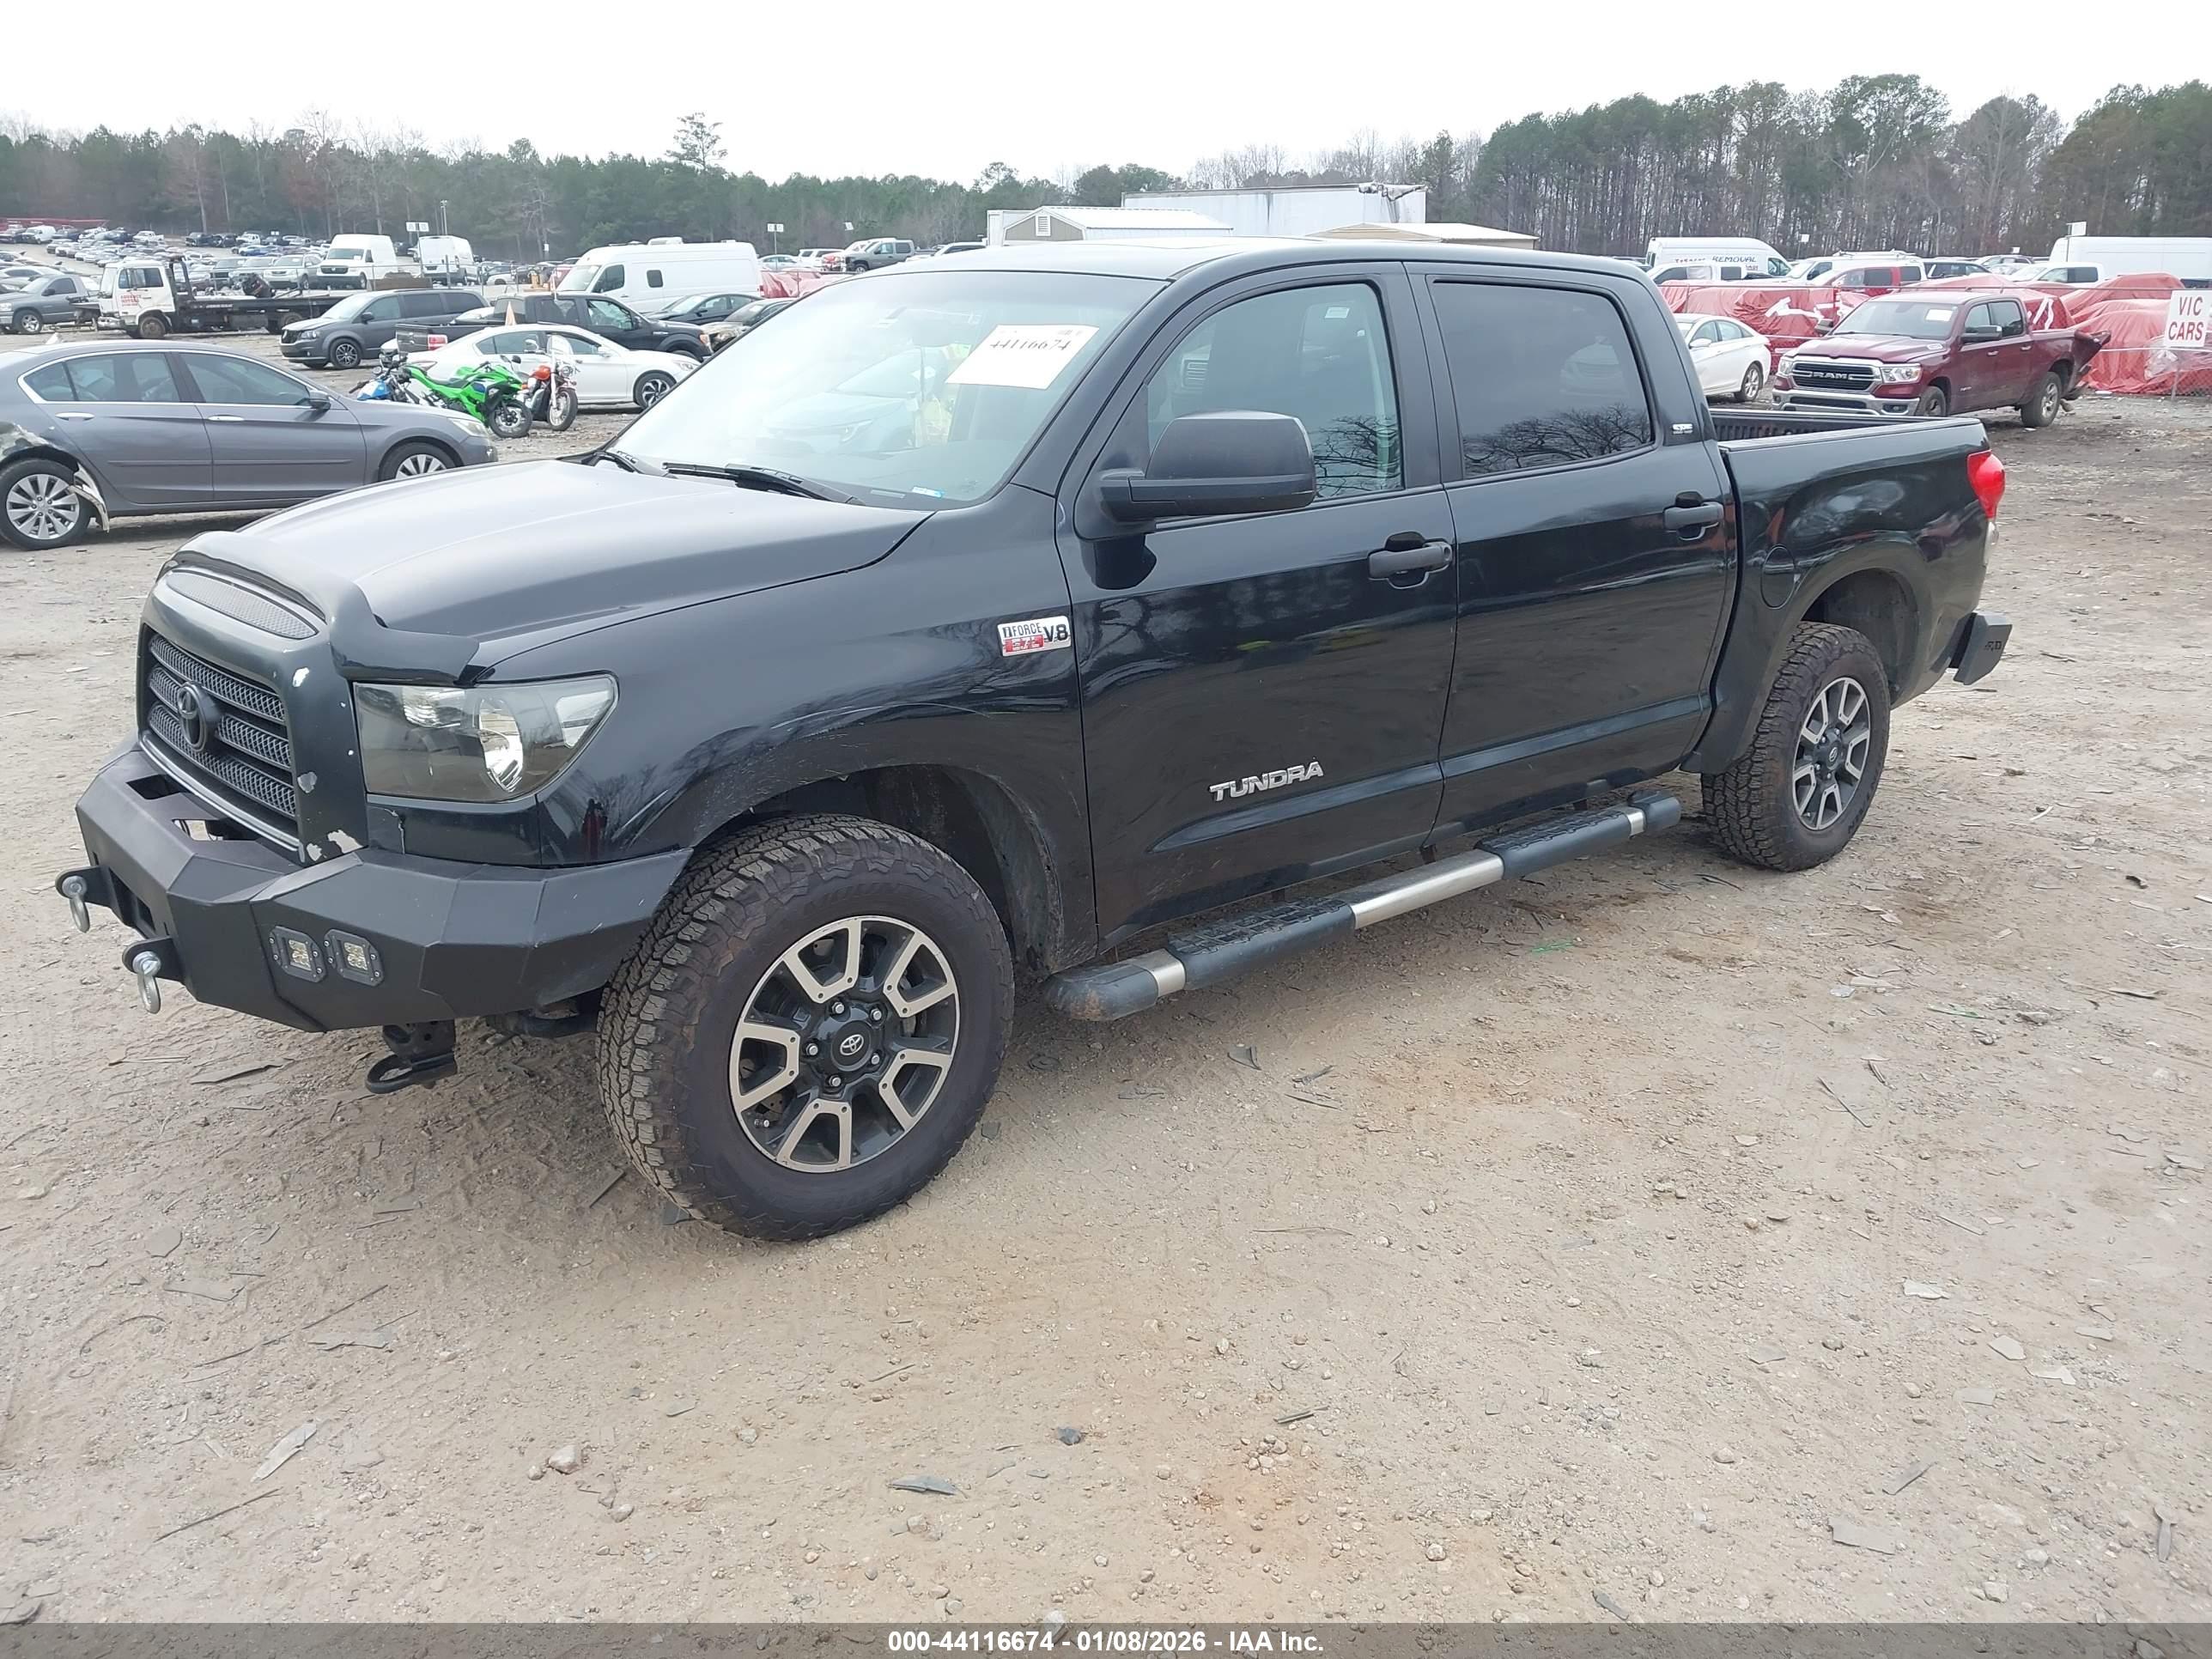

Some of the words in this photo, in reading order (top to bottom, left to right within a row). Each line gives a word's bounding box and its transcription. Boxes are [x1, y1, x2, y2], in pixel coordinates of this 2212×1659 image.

[2179, 296, 2203, 316] VIC
[2168, 321, 2204, 341] CARS
[1043, 623, 1068, 642] V8
[1209, 761, 1324, 802] TUNDRA
